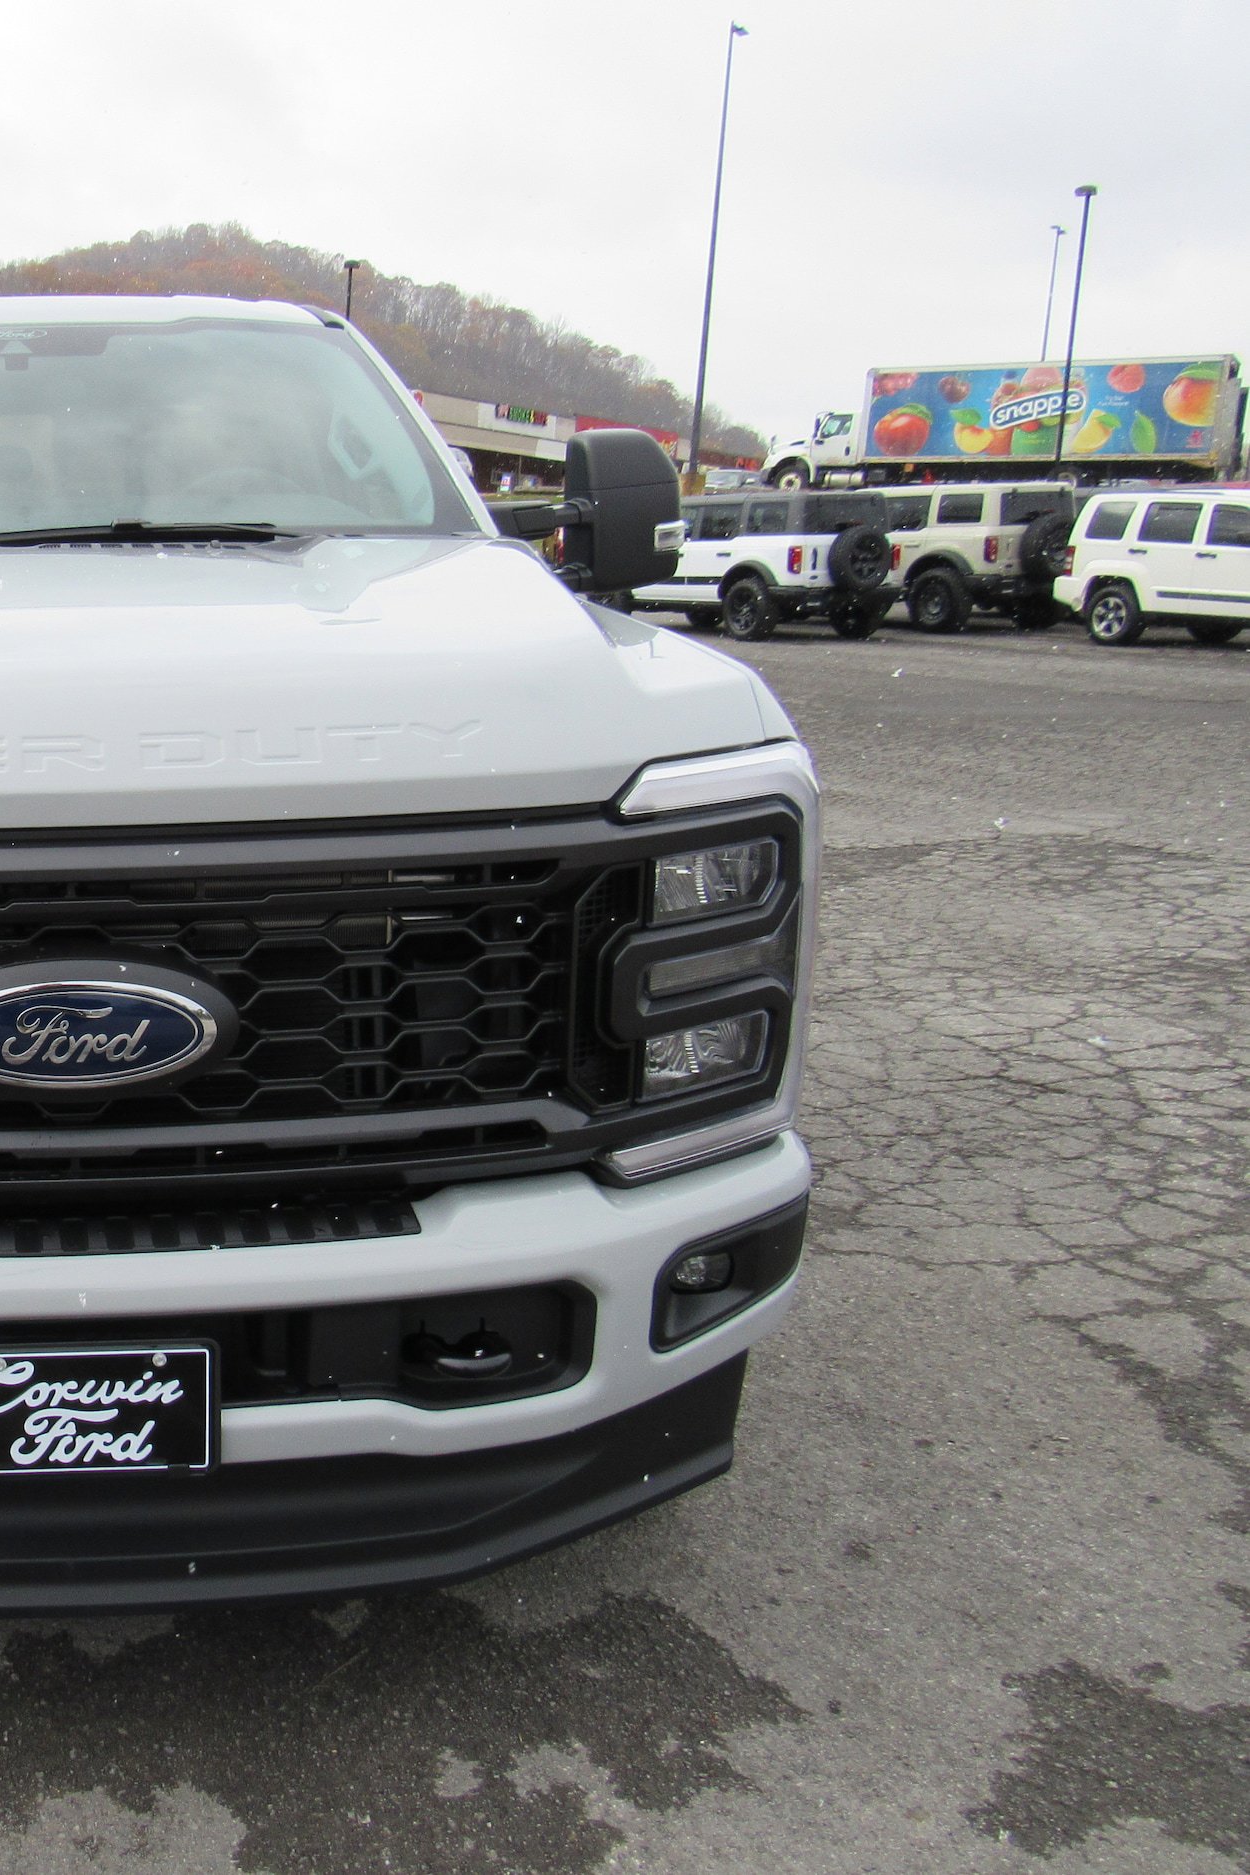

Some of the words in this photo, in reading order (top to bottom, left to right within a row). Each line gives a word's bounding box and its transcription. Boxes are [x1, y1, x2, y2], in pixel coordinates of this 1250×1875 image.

[996, 393, 1080, 424] snappe
[138, 719, 483, 767] DUTY
[3, 1005, 150, 1065] Ford
[9, 1408, 156, 1465] Ford
